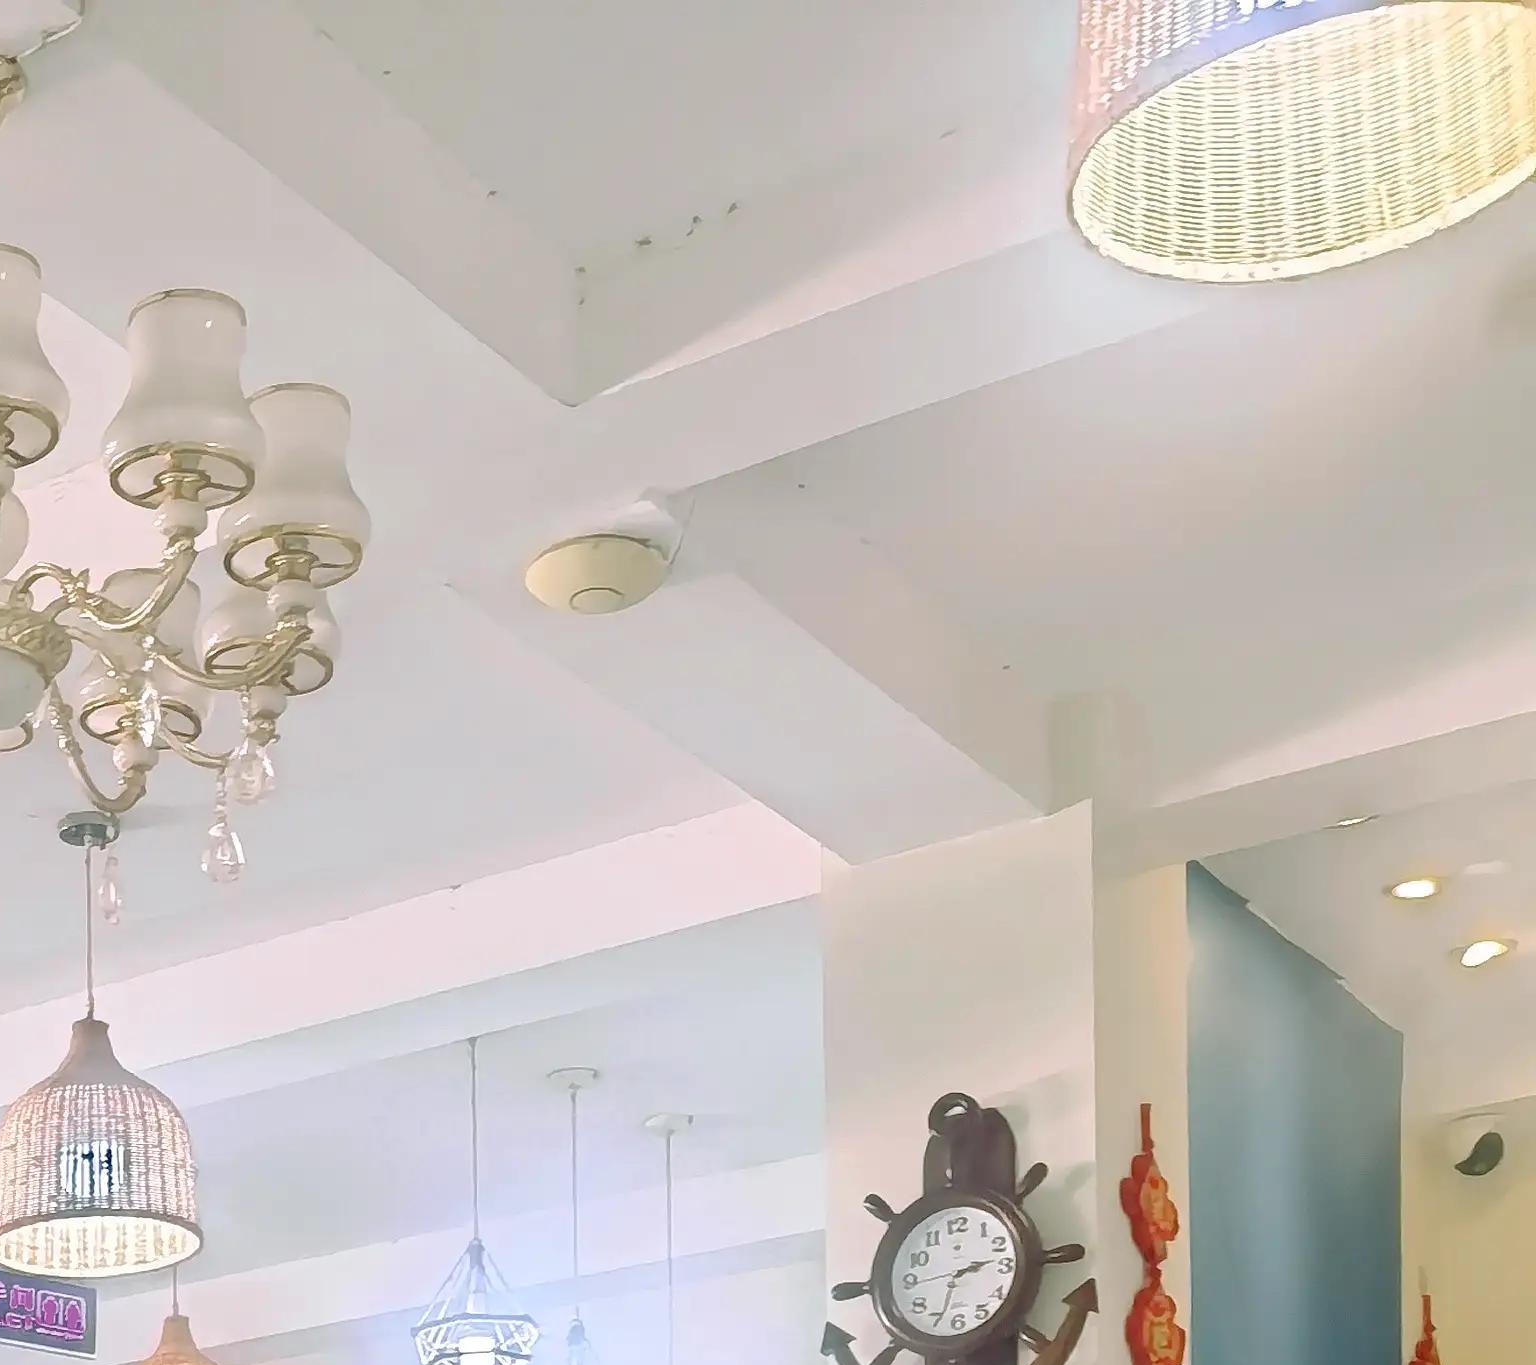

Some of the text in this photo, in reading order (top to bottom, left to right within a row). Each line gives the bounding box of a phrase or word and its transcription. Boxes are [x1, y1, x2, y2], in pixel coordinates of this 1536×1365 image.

[947, 1216, 968, 1235] 12
[980, 1221, 988, 1238] 1
[926, 1230, 940, 1247] 11
[991, 1236, 1006, 1252] 2
[910, 1250, 929, 1268] 10
[997, 1257, 1013, 1274] 3
[903, 1273, 918, 1289] 9
[988, 1285, 1004, 1300] 4
[912, 1297, 927, 1314] 8
[974, 1302, 989, 1320] 5
[928, 1312, 945, 1327] 7
[951, 1313, 966, 1330] 6
